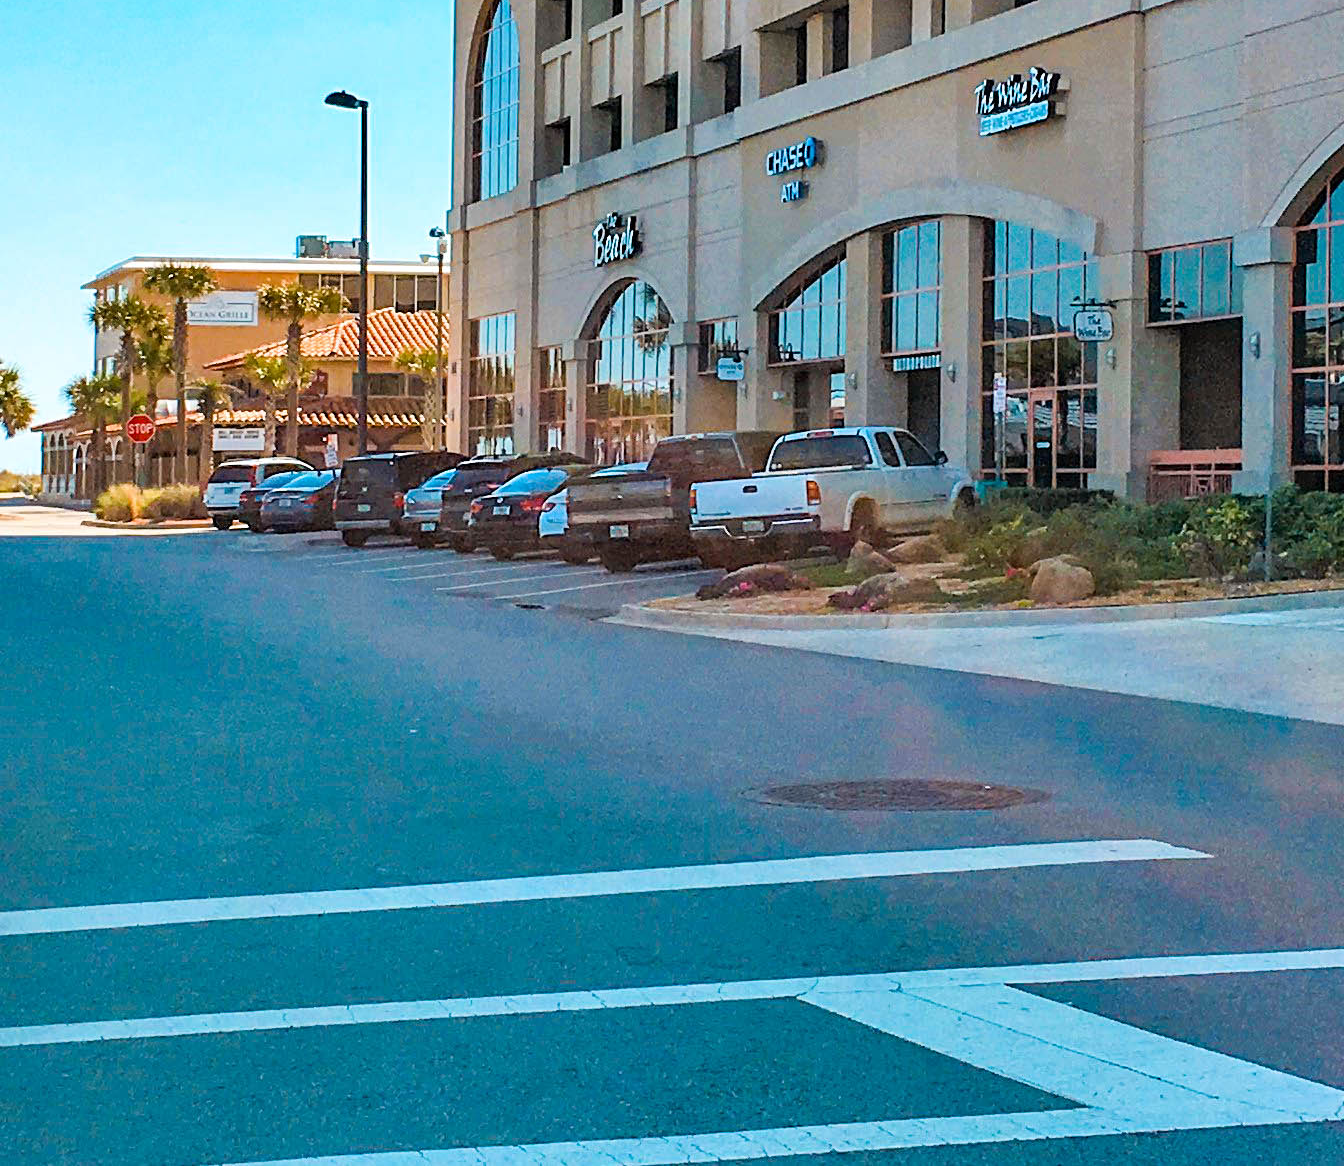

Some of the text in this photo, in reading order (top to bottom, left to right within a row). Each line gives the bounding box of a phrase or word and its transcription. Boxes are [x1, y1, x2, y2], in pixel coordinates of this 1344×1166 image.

[974, 79, 995, 114] The
[996, 75, 1028, 107] Wine
[766, 142, 805, 176] CHASE
[781, 180, 800, 203] ATM
[593, 216, 635, 267] Beach
[128, 423, 153, 434] STOP
